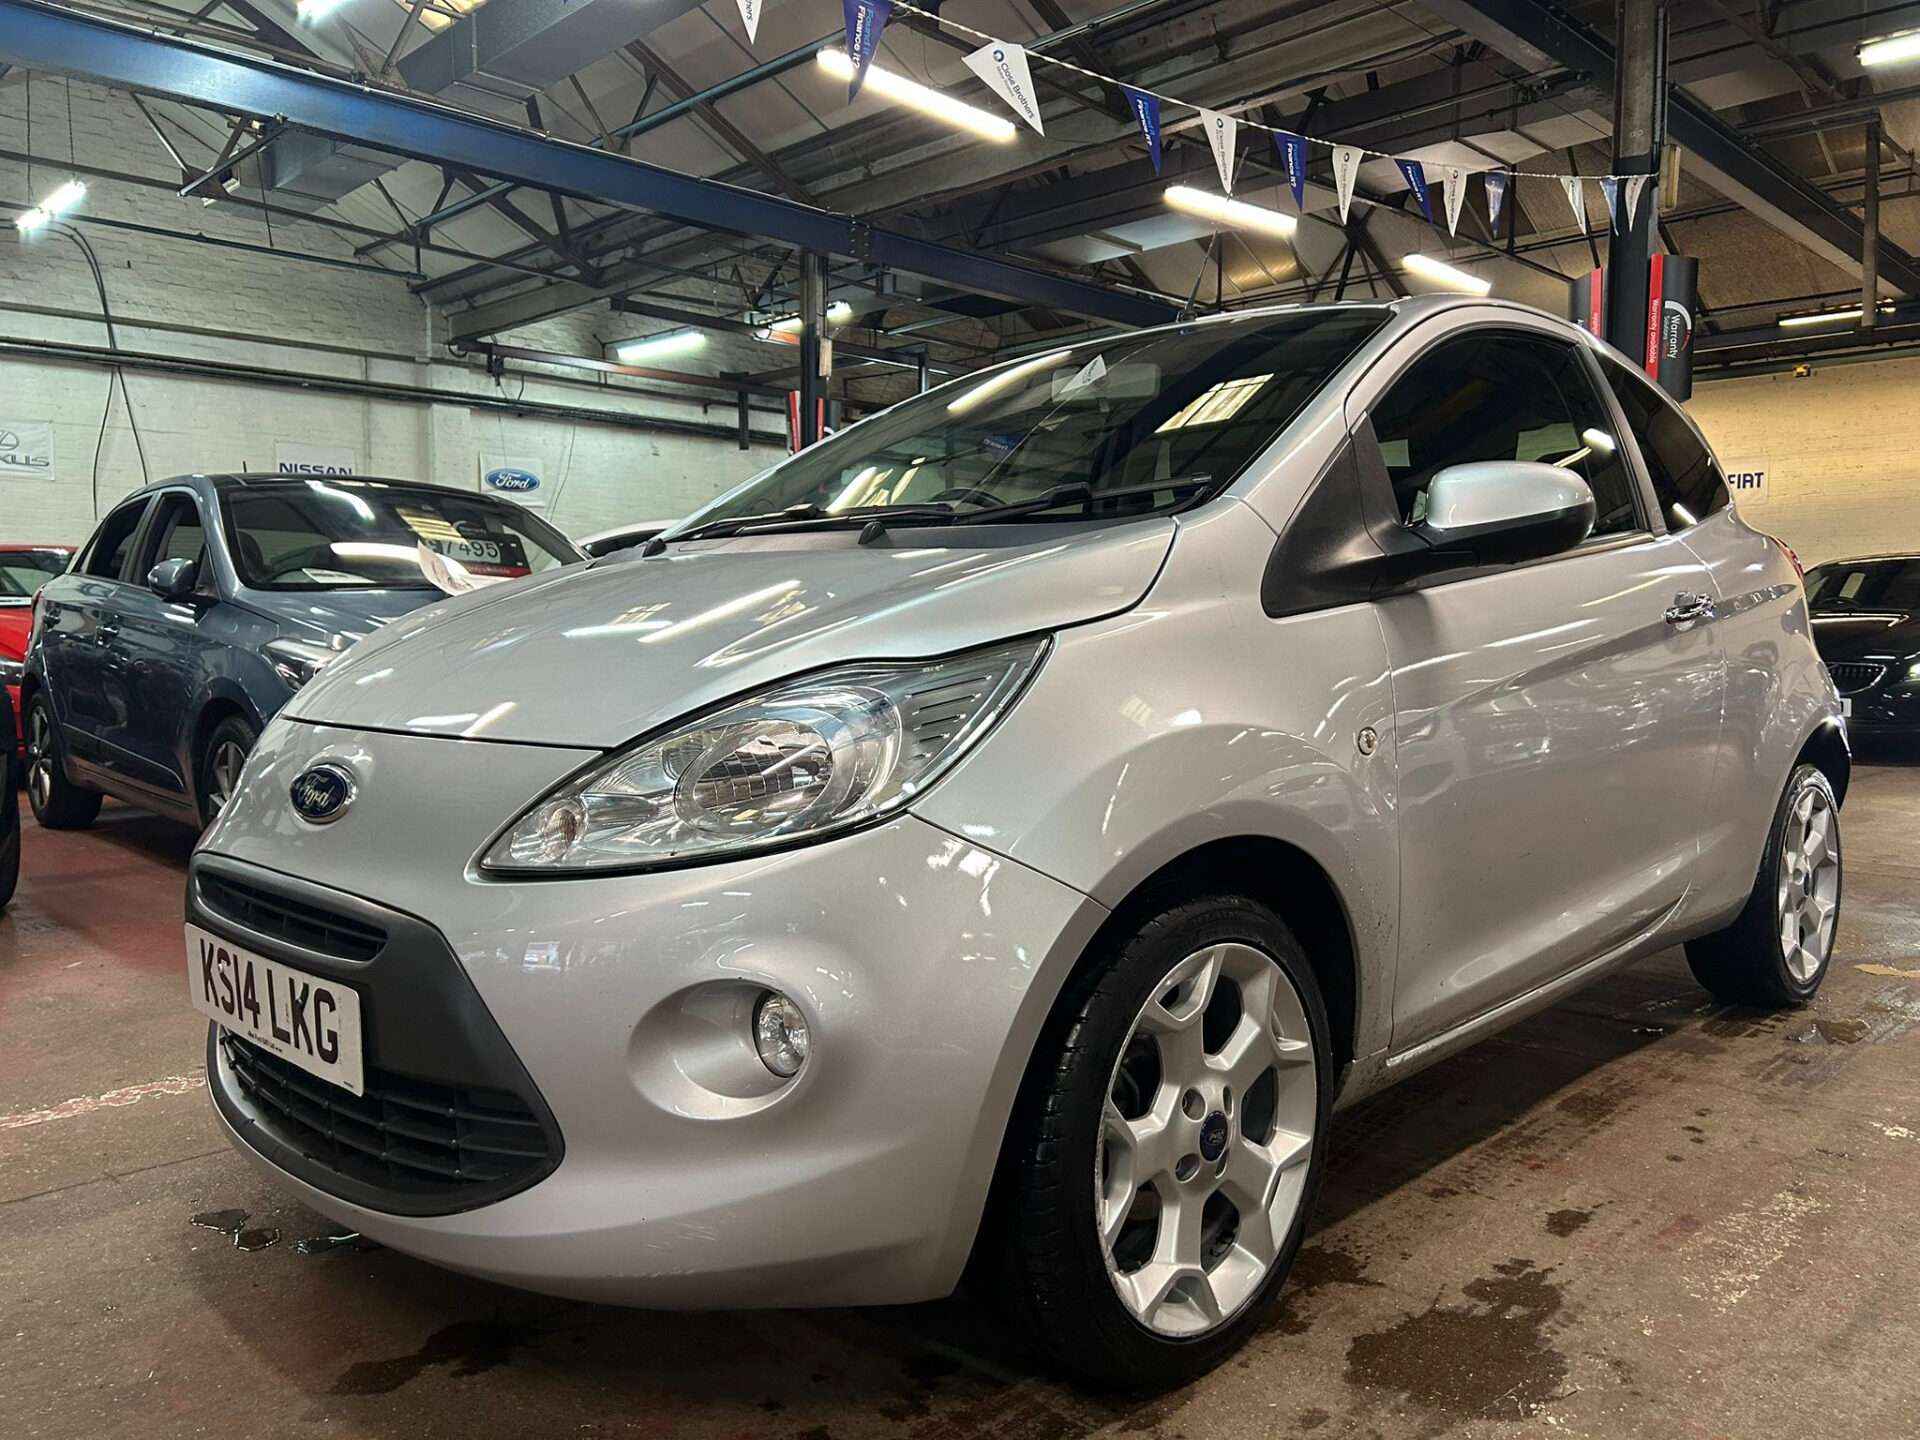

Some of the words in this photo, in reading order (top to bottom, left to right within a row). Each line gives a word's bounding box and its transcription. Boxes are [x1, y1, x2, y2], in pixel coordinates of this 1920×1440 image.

[853, 5, 866, 51] Finance
[863, 8, 875, 43] Found
[852, 54, 862, 70] it?
[1000, 62, 1015, 86] Close
[1012, 85, 1035, 119] Brothers
[1650, 298, 1660, 331] Warranty
[1663, 315, 1671, 340] Solutions
[1649, 332, 1658, 364] available
[1667, 314, 1681, 359] Warranty
[279, 462, 353, 476] NISSAN
[495, 471, 530, 489] Ford
[1727, 471, 1765, 490] FIAT
[297, 772, 336, 809] Ford
[199, 938, 261, 1030] KS14
[266, 968, 339, 1065] LKG
